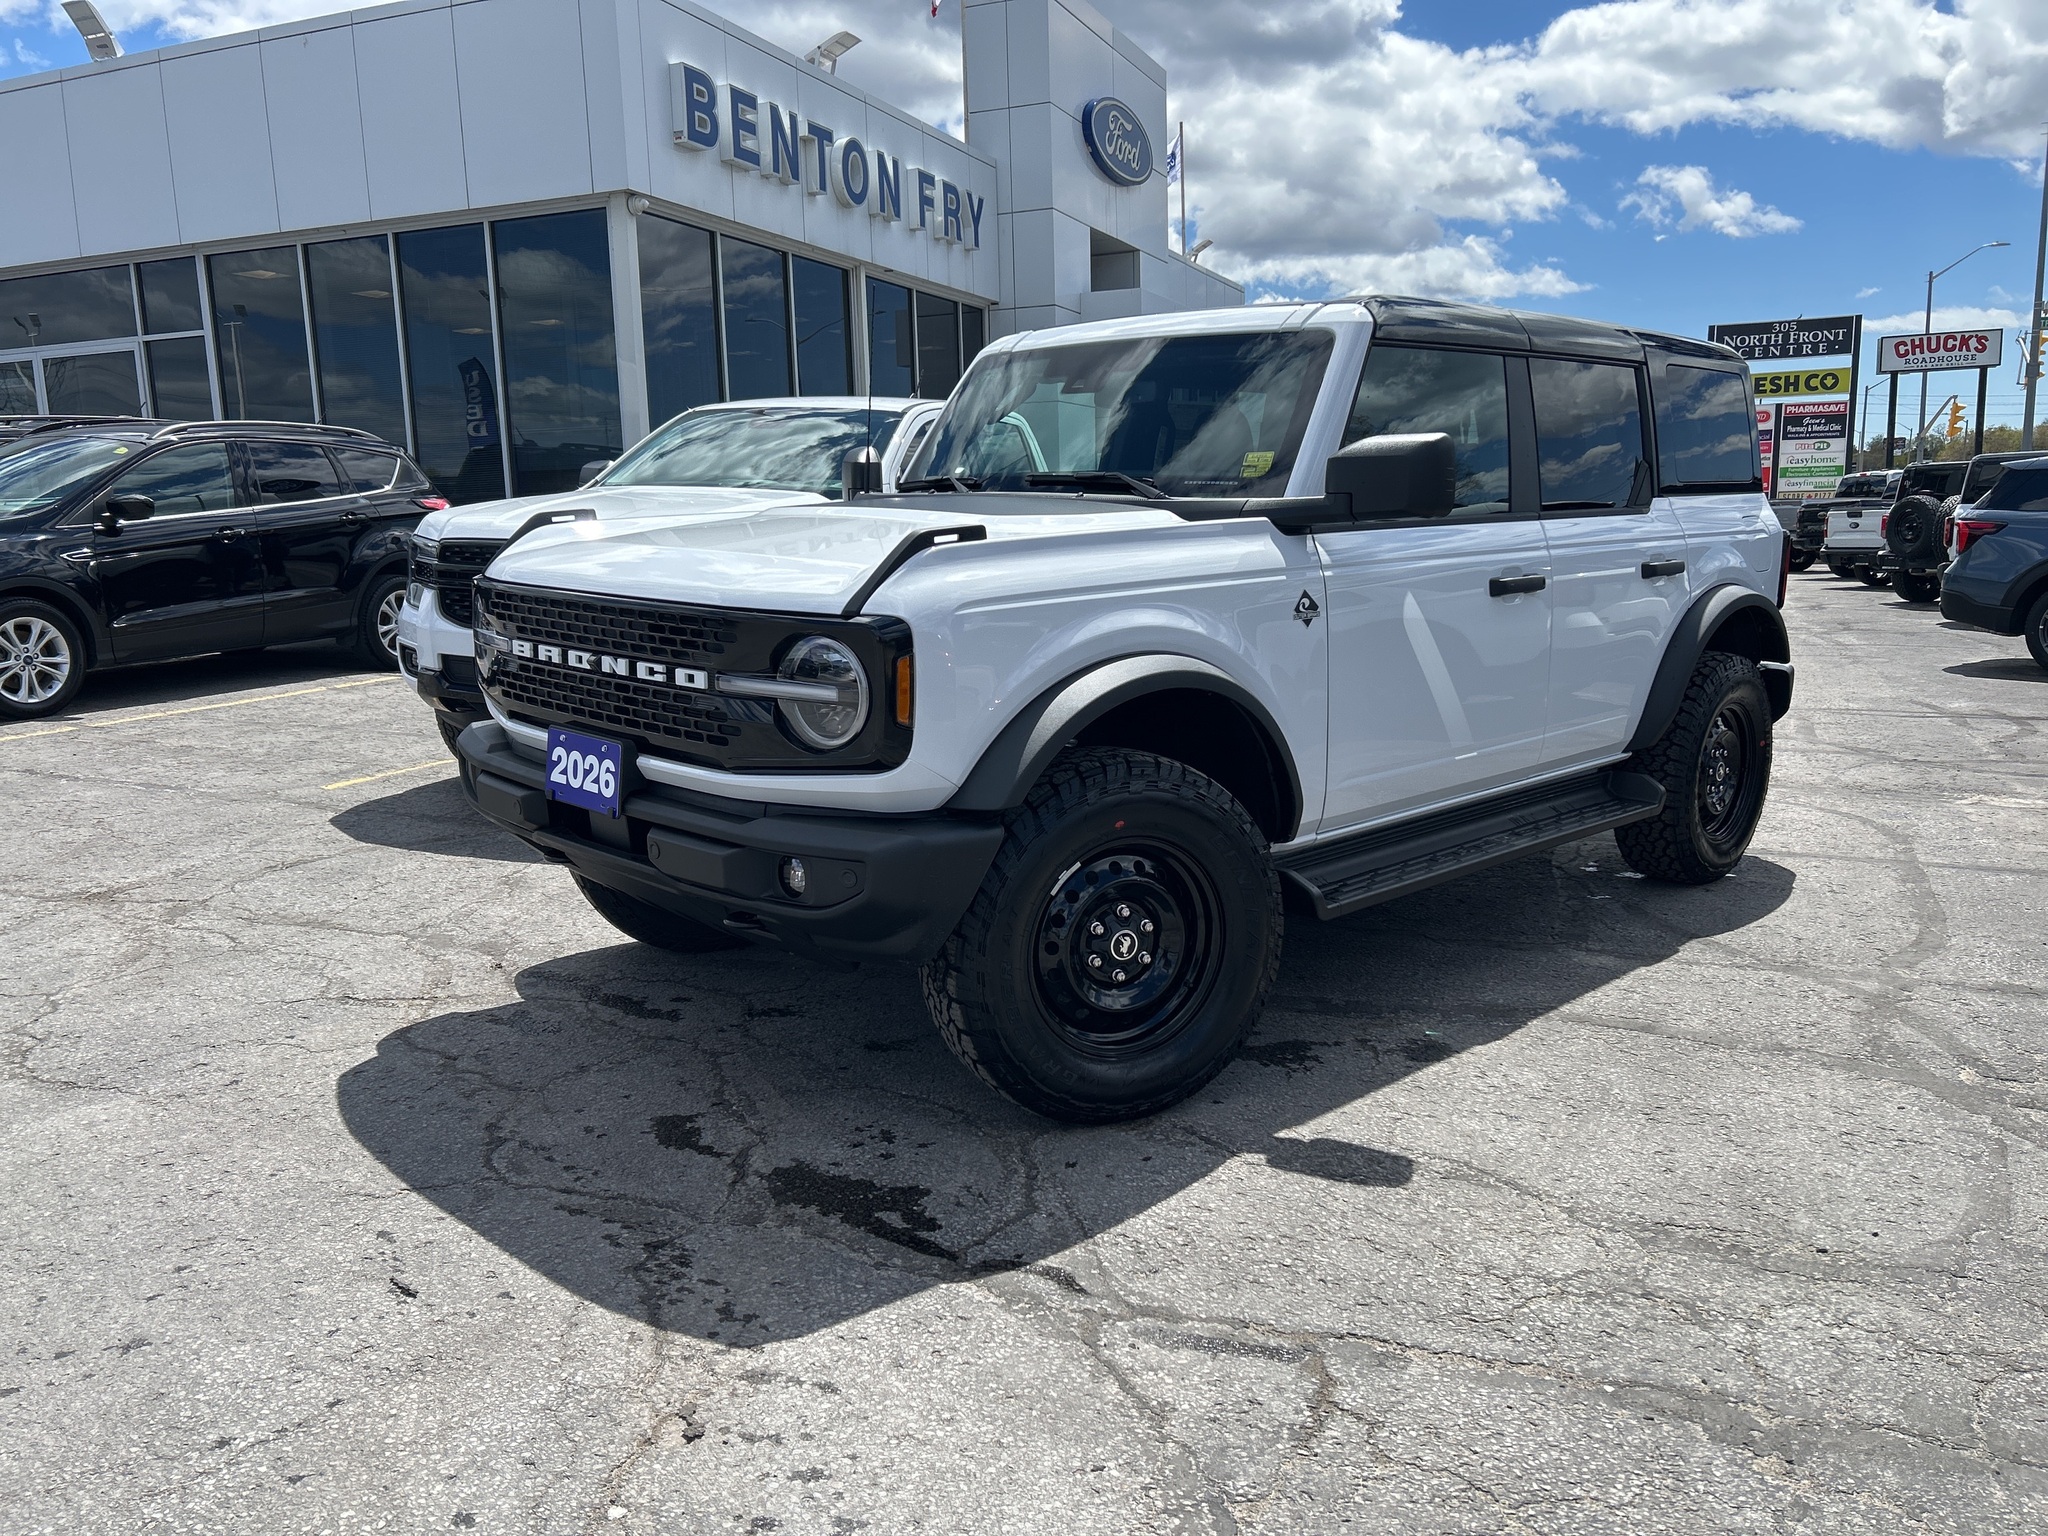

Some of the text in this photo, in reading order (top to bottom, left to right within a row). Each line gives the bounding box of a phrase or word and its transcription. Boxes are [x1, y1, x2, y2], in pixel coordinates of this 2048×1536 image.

[1105, 110, 1141, 171] Ford
[669, 62, 985, 250] BENTON FRY
[1772, 321, 1797, 333] 305
[1723, 329, 1847, 348] NORTH FRONT
[1893, 333, 1990, 359] CHUCK'S
[1739, 342, 1828, 359] CENTRE
[1904, 353, 1977, 365] ROADHOUSE
[1786, 403, 1846, 414] PHARMASAVE
[1786, 425, 1808, 433] Pharmacy
[1812, 423, 1830, 431] Medical
[1829, 423, 1842, 431] Clinic
[1789, 455, 1838, 466] easyhome
[512, 639, 709, 690] BRONCO
[550, 746, 616, 798] 2026
